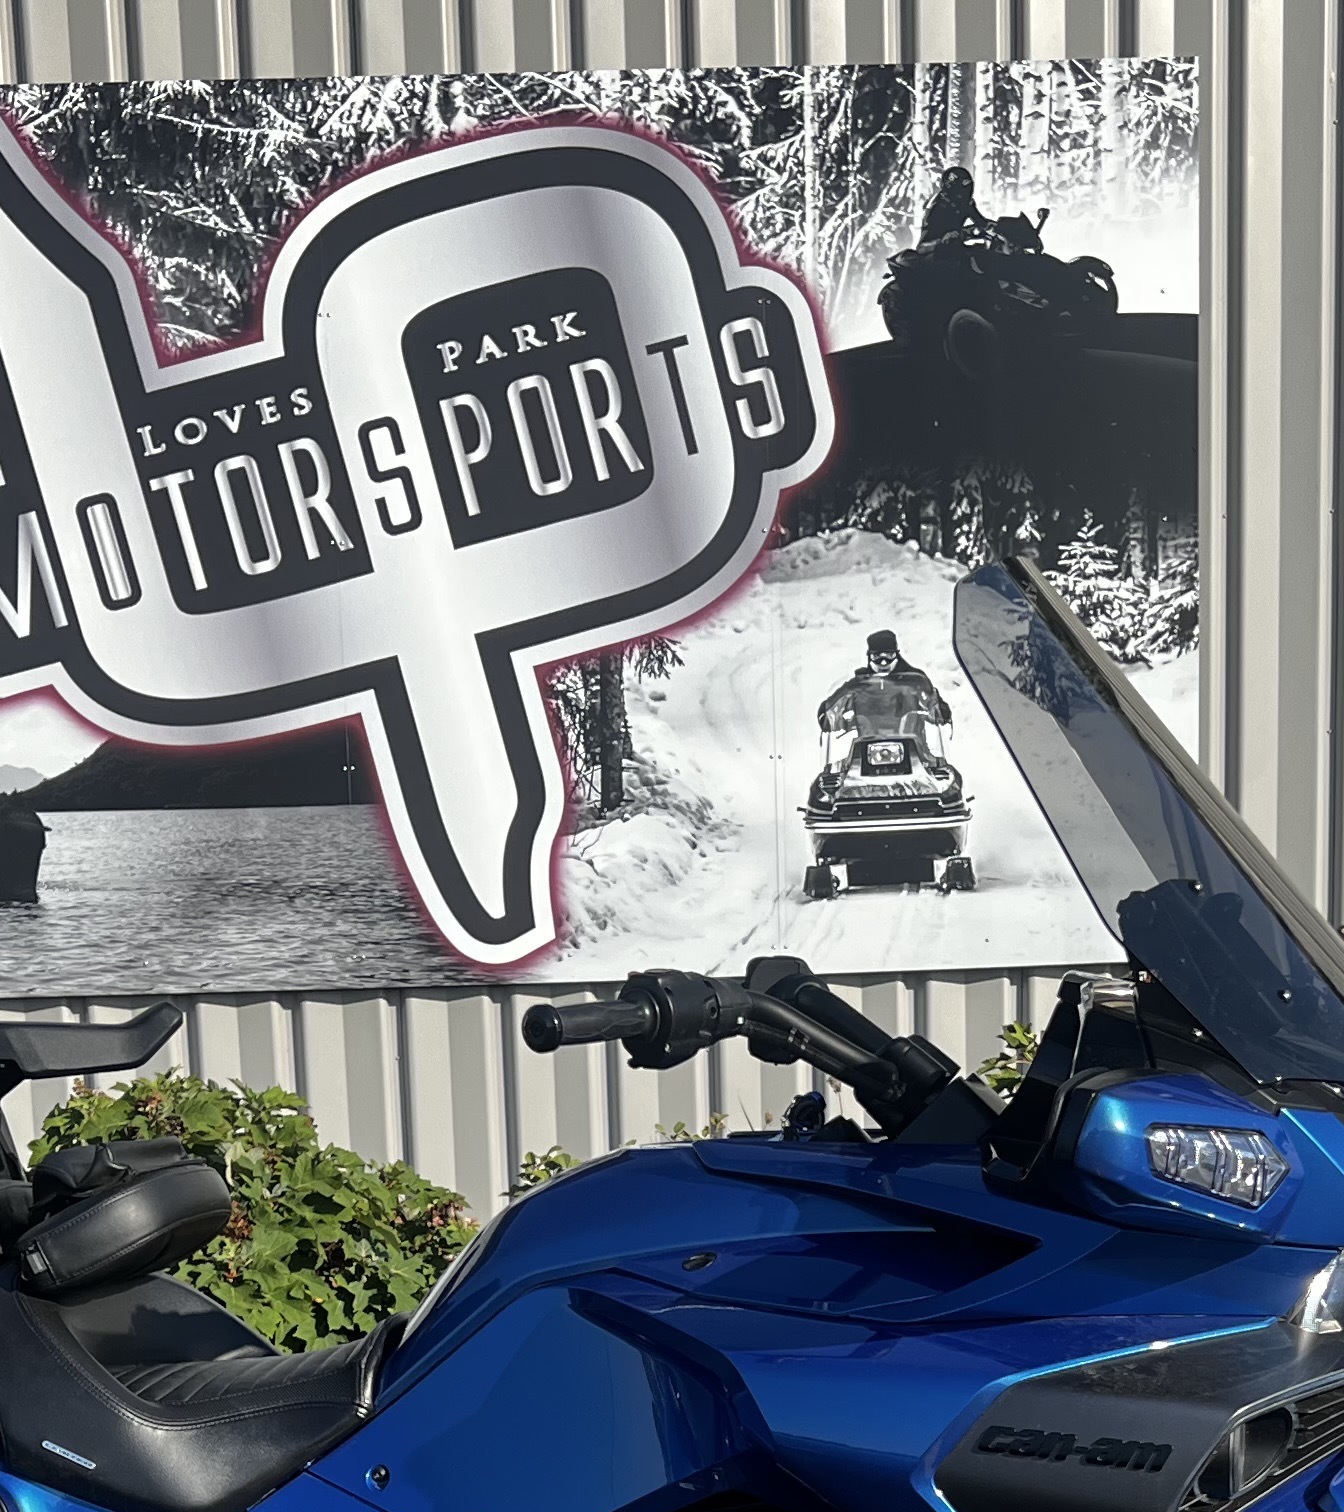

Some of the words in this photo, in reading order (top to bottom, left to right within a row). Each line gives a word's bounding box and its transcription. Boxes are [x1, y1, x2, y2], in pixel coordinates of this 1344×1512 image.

[437, 311, 587, 374] PARK
[136, 386, 315, 456] LOVES
[974, 1425, 1174, 1473] can-am
